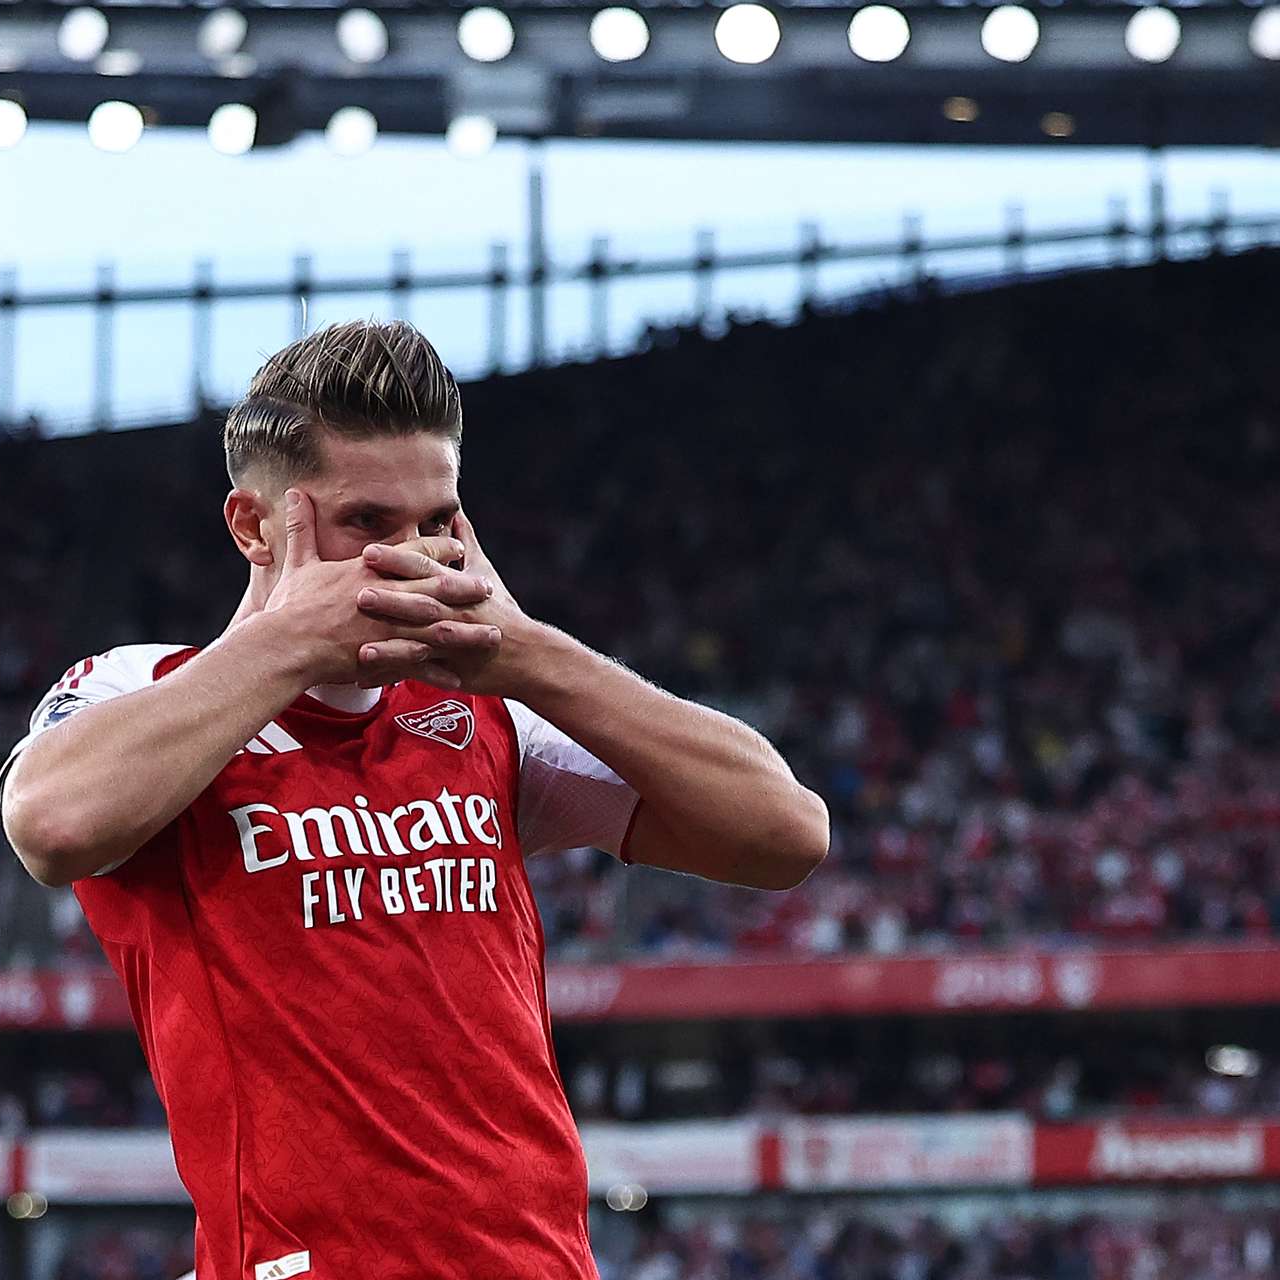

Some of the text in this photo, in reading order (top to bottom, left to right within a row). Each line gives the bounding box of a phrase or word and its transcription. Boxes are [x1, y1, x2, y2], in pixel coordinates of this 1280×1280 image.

[407, 703, 457, 726] Arsenal
[302, 858, 498, 928] FLY BETTER
